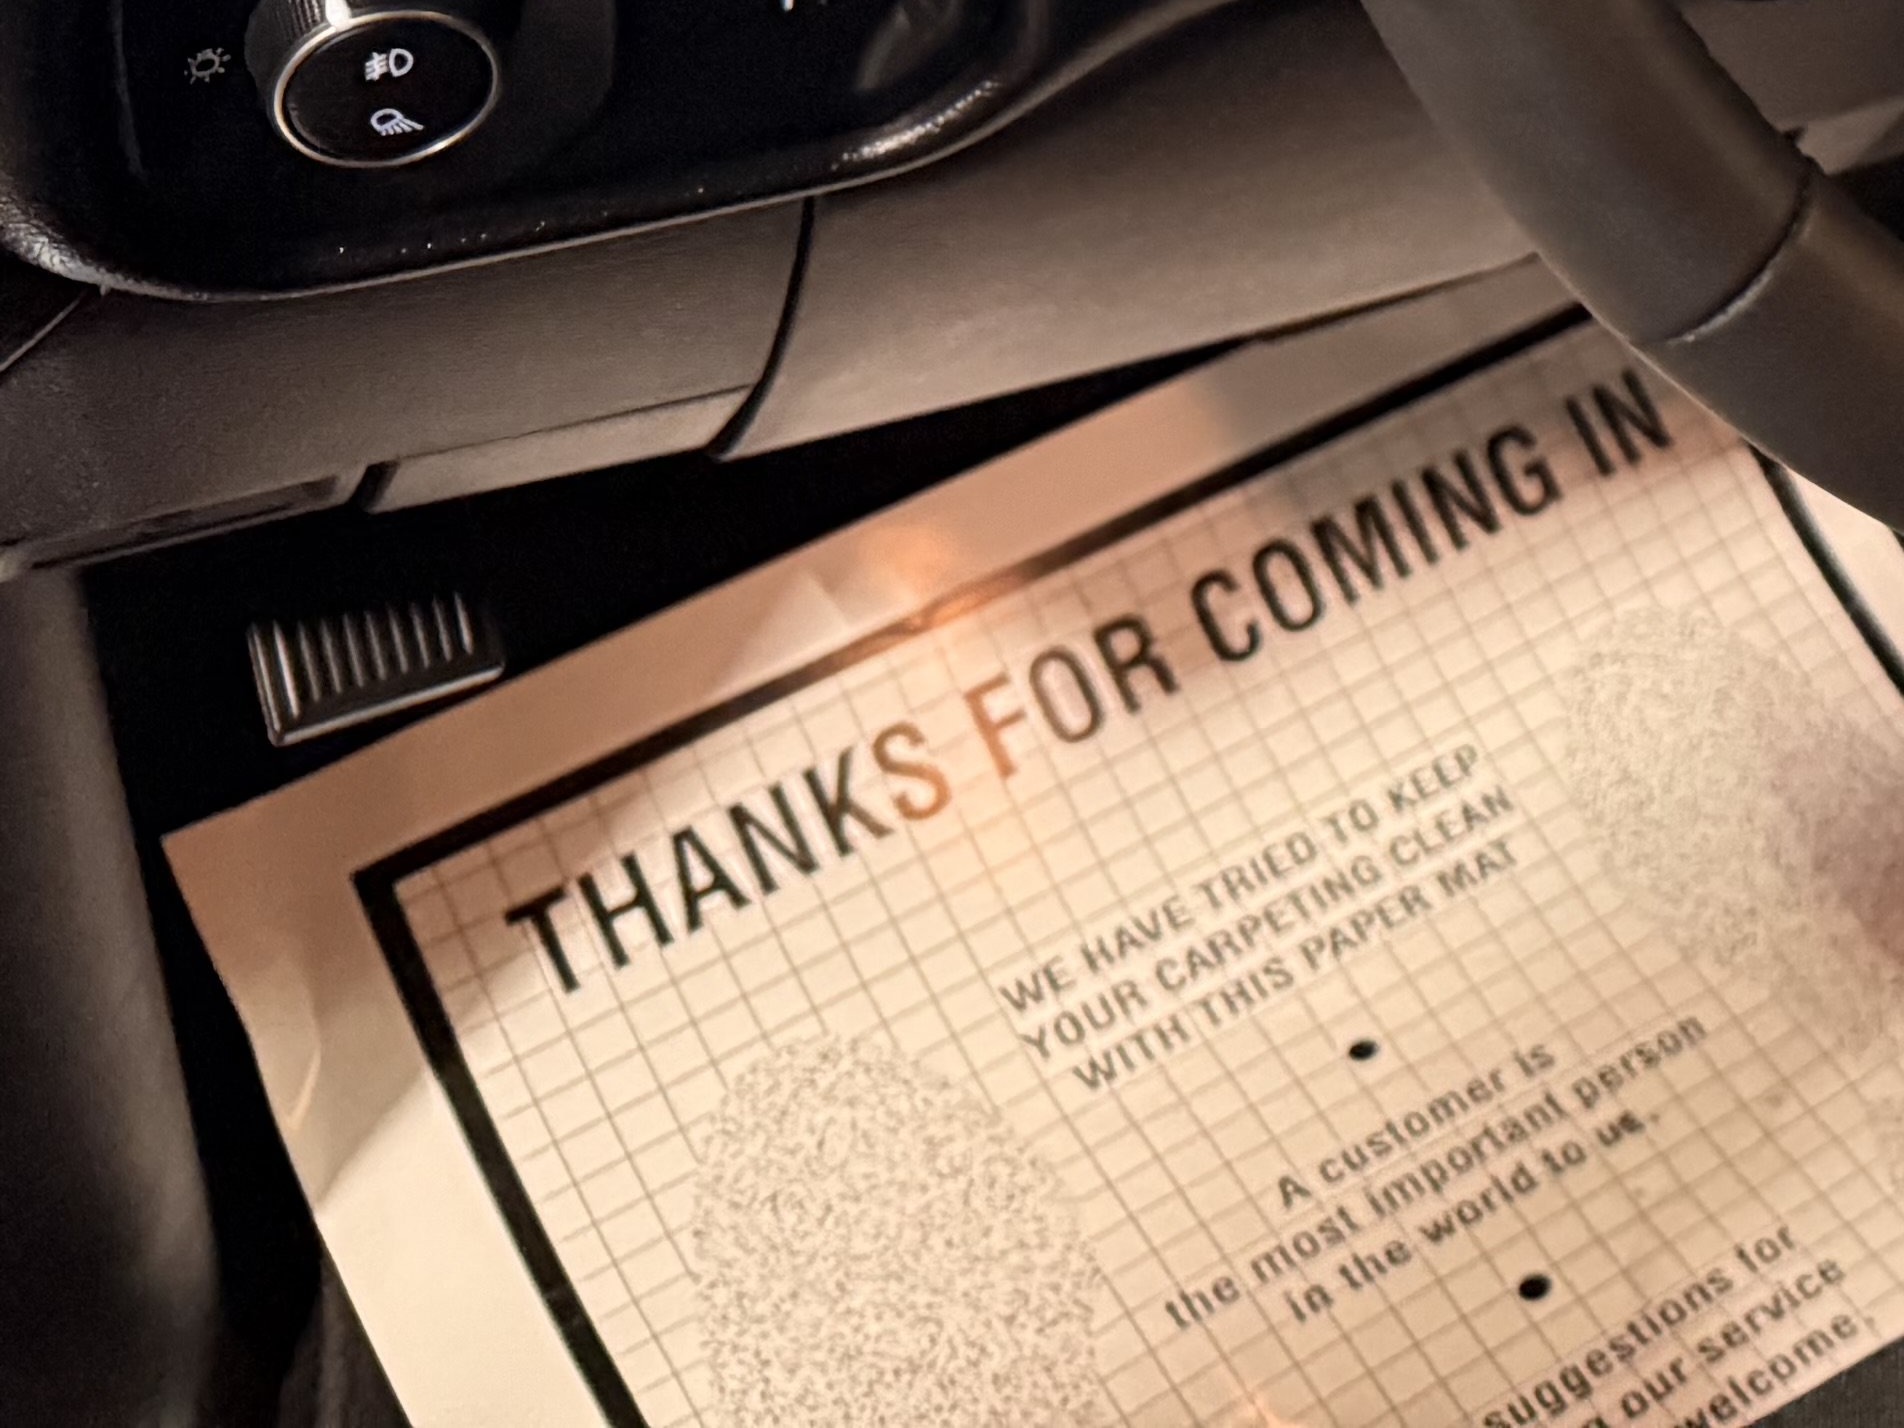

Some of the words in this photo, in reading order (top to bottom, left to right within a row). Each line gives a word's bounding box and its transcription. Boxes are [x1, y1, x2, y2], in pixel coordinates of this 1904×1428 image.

[504, 721, 952, 994] THANKS
[964, 613, 1179, 778] FOR
[1190, 424, 1564, 664] COMING
[1565, 369, 1674, 476] IN
[999, 957, 1075, 1013] WE
[1080, 896, 1195, 973] HAVE
[1199, 832, 1319, 912] TRIED
[1323, 799, 1379, 844] TO
[1385, 744, 1479, 811] KEEP
[1021, 979, 1150, 1061] YOUR
[1154, 856, 1383, 994] CARPETING
[1389, 785, 1514, 868] CLEAN
[1073, 1017, 1191, 1091] WITH
[1199, 958, 1294, 1029] THIS
[1301, 891, 1431, 972] PAPER
[1437, 842, 1518, 897] MAT
[1164, 1273, 1241, 1331] the
[1249, 1204, 1360, 1285] most
[1364, 1088, 1566, 1220] important
[1572, 1014, 1707, 1110] person
[1276, 1175, 1310, 1209] A
[1318, 1069, 1506, 1184] customer
[1514, 1043, 1556, 1078] is
[1283, 1285, 1333, 1324] in
[1338, 1238, 1412, 1291] the
[1419, 1164, 1539, 1245] world
[1541, 1144, 1586, 1177] to
[1484, 1267, 1735, 1428] suggestions
[1736, 1223, 1797, 1272] for
[1620, 1354, 1688, 1419] our
[1697, 1256, 1846, 1365] service
